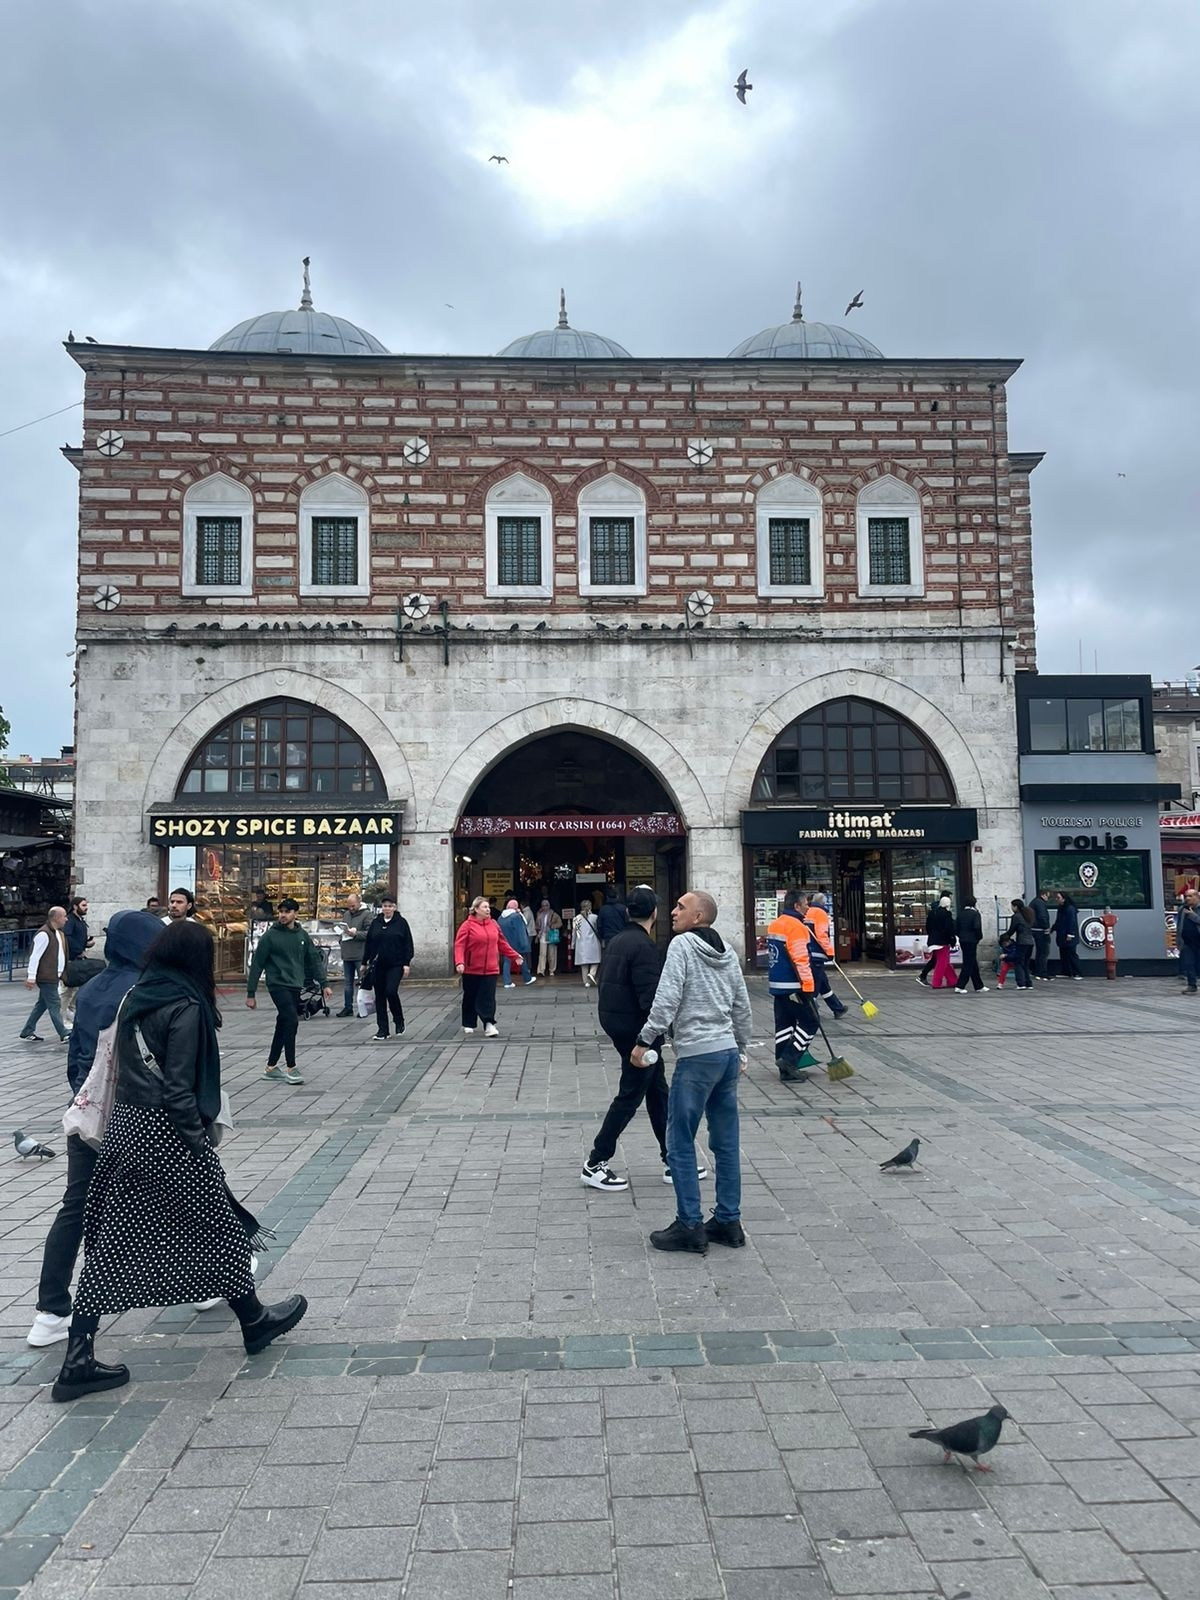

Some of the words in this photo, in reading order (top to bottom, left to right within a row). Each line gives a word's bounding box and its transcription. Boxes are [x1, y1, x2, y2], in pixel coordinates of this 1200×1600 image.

[514, 821, 547, 830] MISIR
[549, 821, 594, 831] ÇARŞISI
[596, 821, 627, 831] (1664)
[828, 812, 893, 828] itimat
[1040, 816, 1093, 828] TOURISM
[1099, 816, 1144, 828] POLICE
[154, 819, 230, 837] SHOZY
[236, 819, 297, 836] SPICE
[303, 818, 394, 835] BAZAAR
[799, 829, 839, 838] FABRİKA
[844, 830, 872, 839] SATIŞ
[876, 828, 925, 838] MAĞAZASI
[1058, 832, 1129, 850] POLİS
